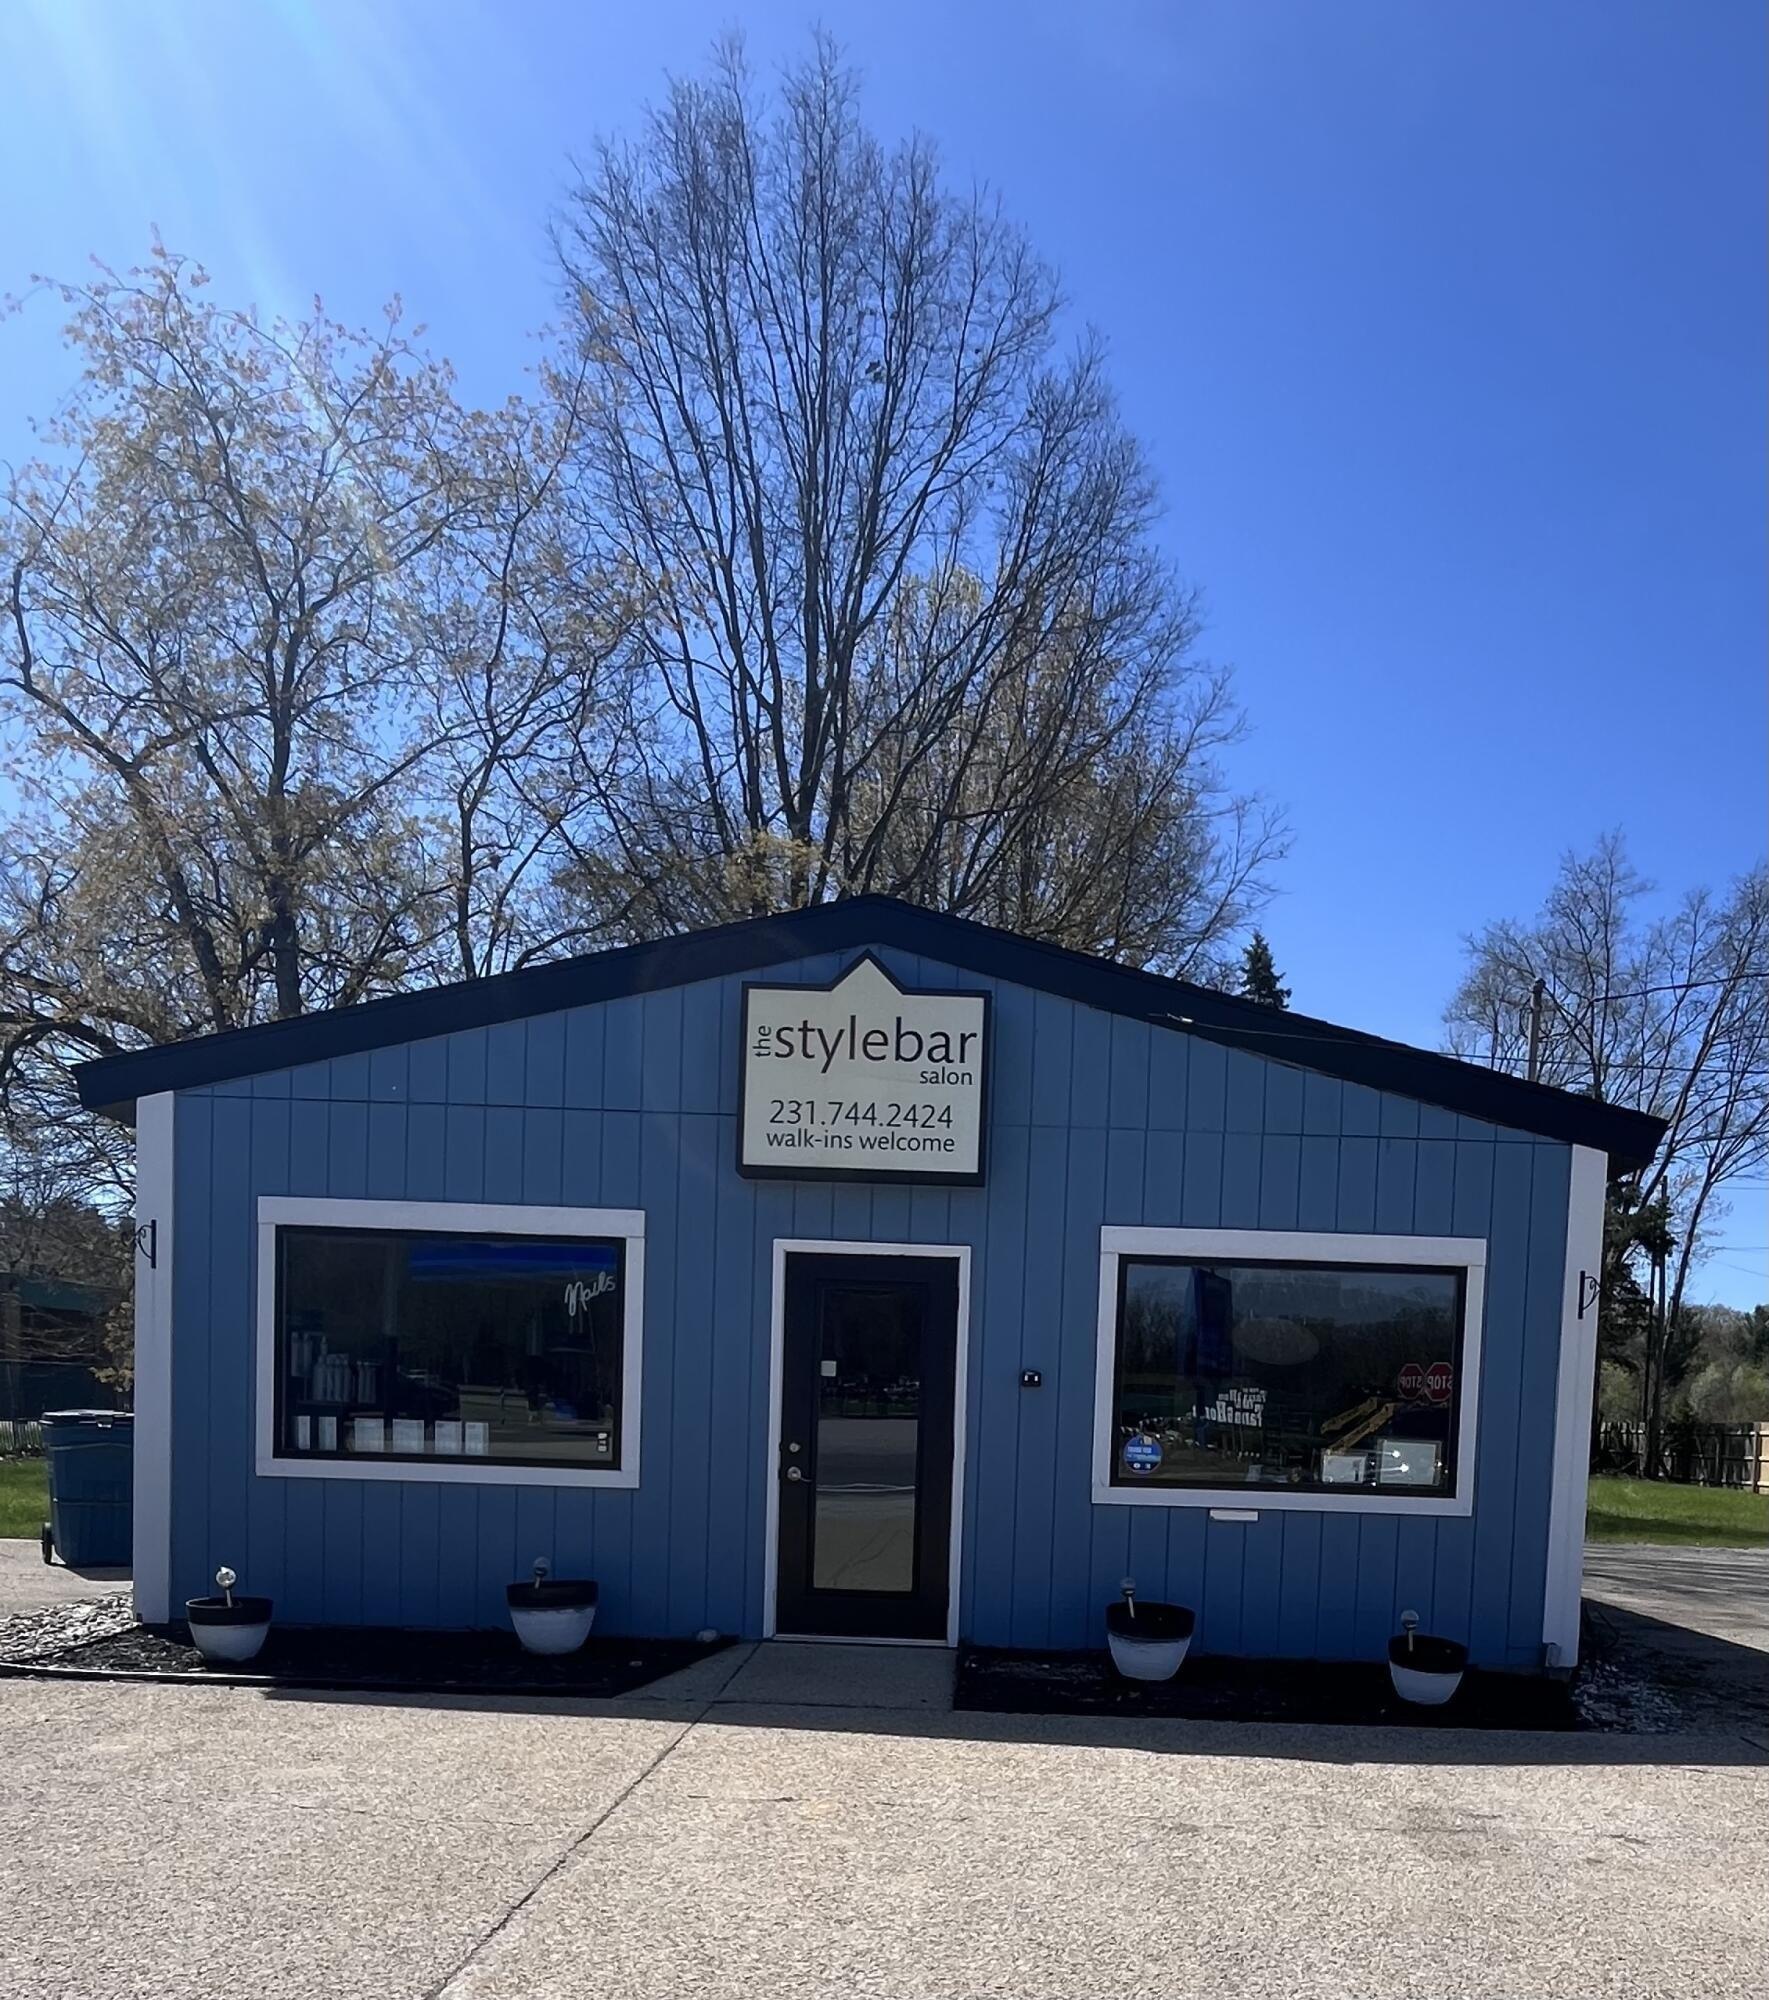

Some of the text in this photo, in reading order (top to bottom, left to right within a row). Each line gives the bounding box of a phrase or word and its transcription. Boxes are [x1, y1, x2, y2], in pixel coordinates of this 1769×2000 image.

[752, 1025, 772, 1058] the
[774, 1015, 978, 1073] stylebar
[919, 1067, 973, 1085] salon
[769, 1100, 953, 1129] 231.744.2424
[766, 1128, 955, 1152] walk-ins welcome
[564, 1271, 616, 1317] Nails
